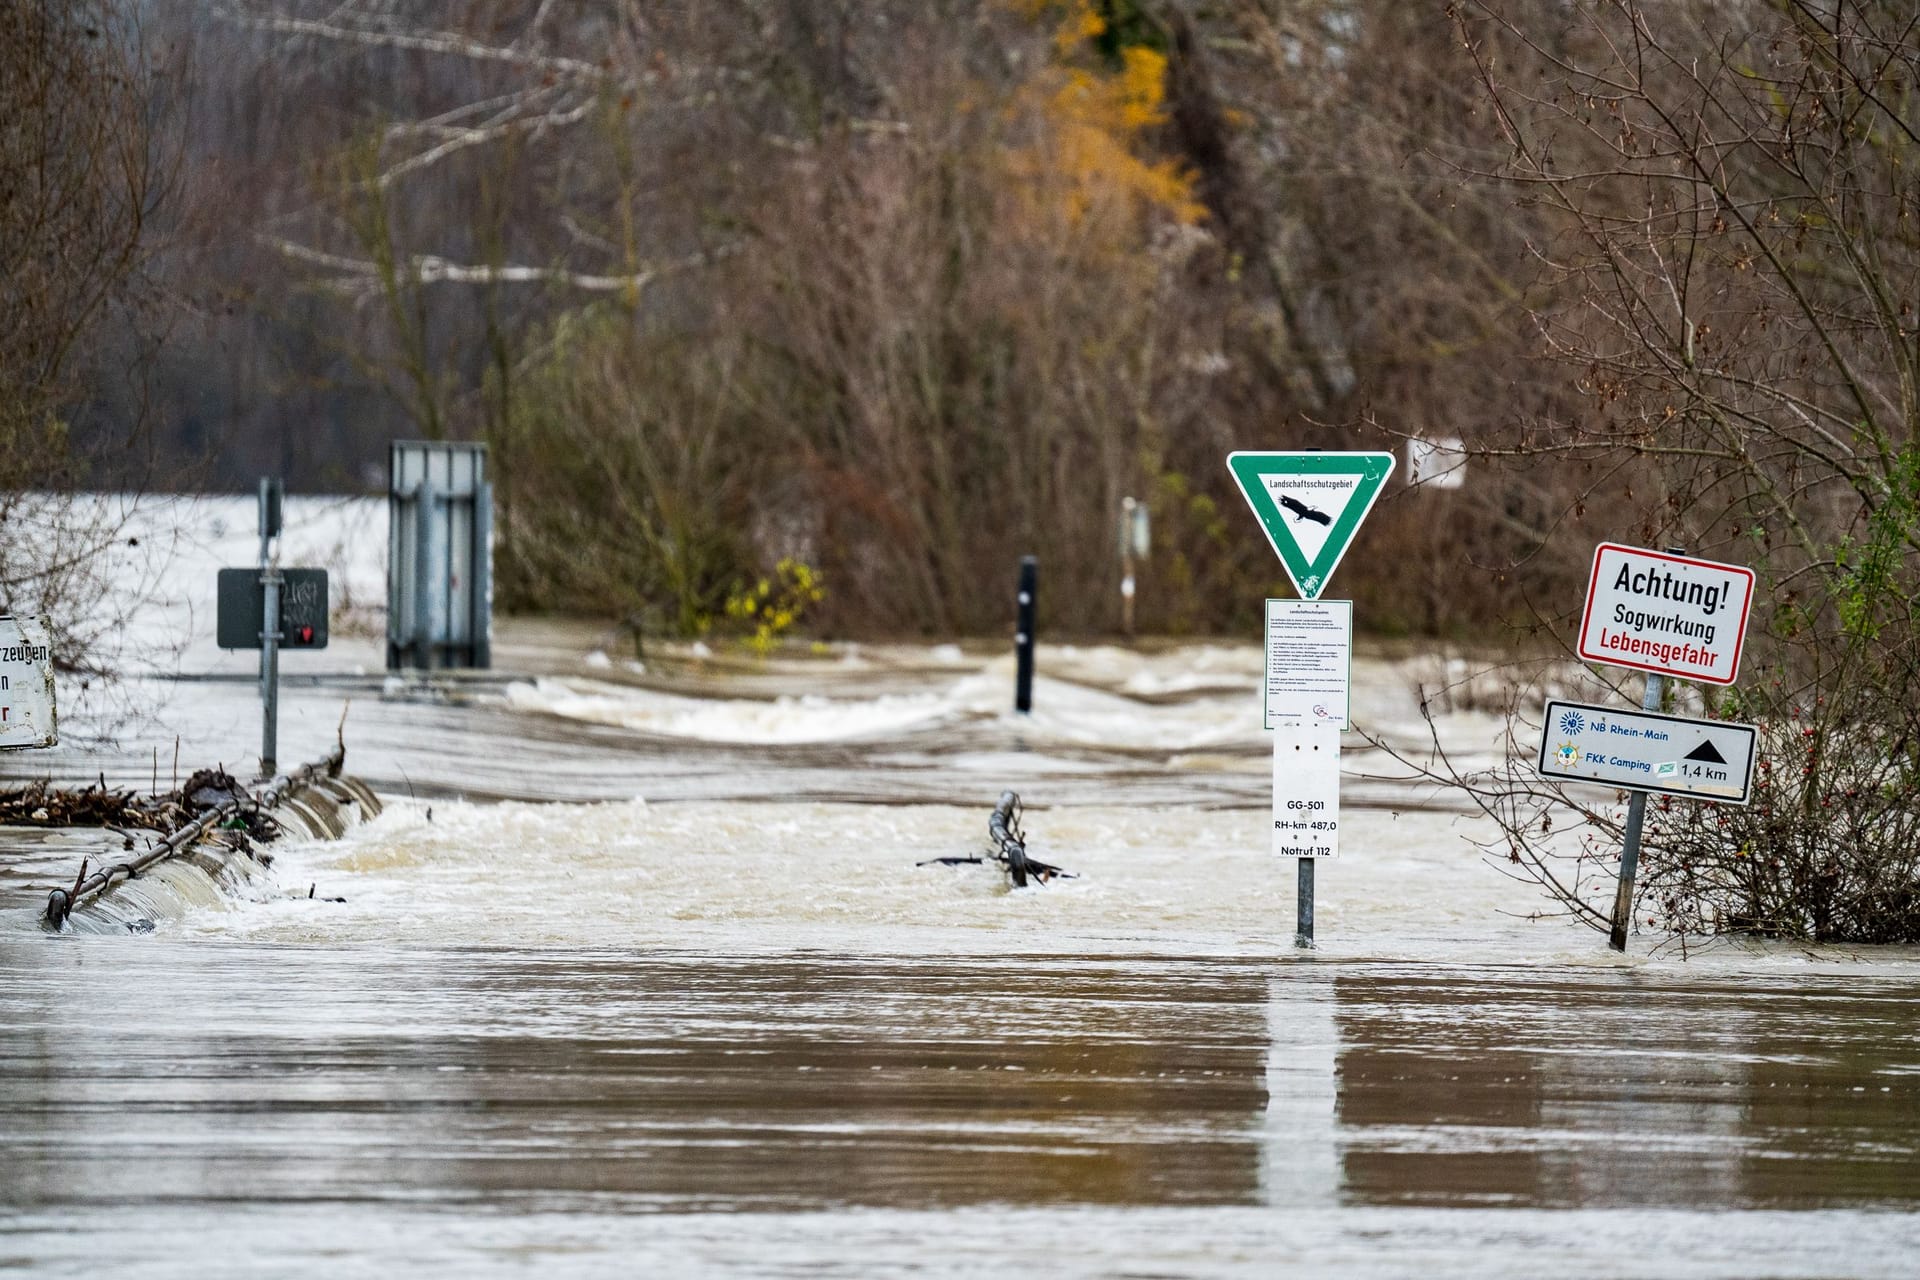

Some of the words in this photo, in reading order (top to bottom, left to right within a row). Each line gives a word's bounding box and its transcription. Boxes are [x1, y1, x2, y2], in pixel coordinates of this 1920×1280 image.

[1269, 480, 1353, 490] Landschaftsschutzgebiet
[1613, 562, 1730, 615] Achtung!
[1613, 603, 1715, 645] Sogwirkung
[0, 646, 47, 665] zeugen
[1600, 627, 1718, 668] Lebensgefahr
[1590, 721, 1607, 733] NB
[1610, 724, 1669, 741] Rhein-Main
[1585, 752, 1606, 764] FKK
[1610, 756, 1651, 773] Camping
[1681, 764, 1702, 779] 1,4
[1705, 767, 1727, 781] km
[1287, 800, 1325, 810] GG-501
[1274, 820, 1307, 829] RH-km
[1310, 821, 1337, 832] 487,0
[1281, 846, 1314, 855] Notruf
[1316, 847, 1331, 856] 112
